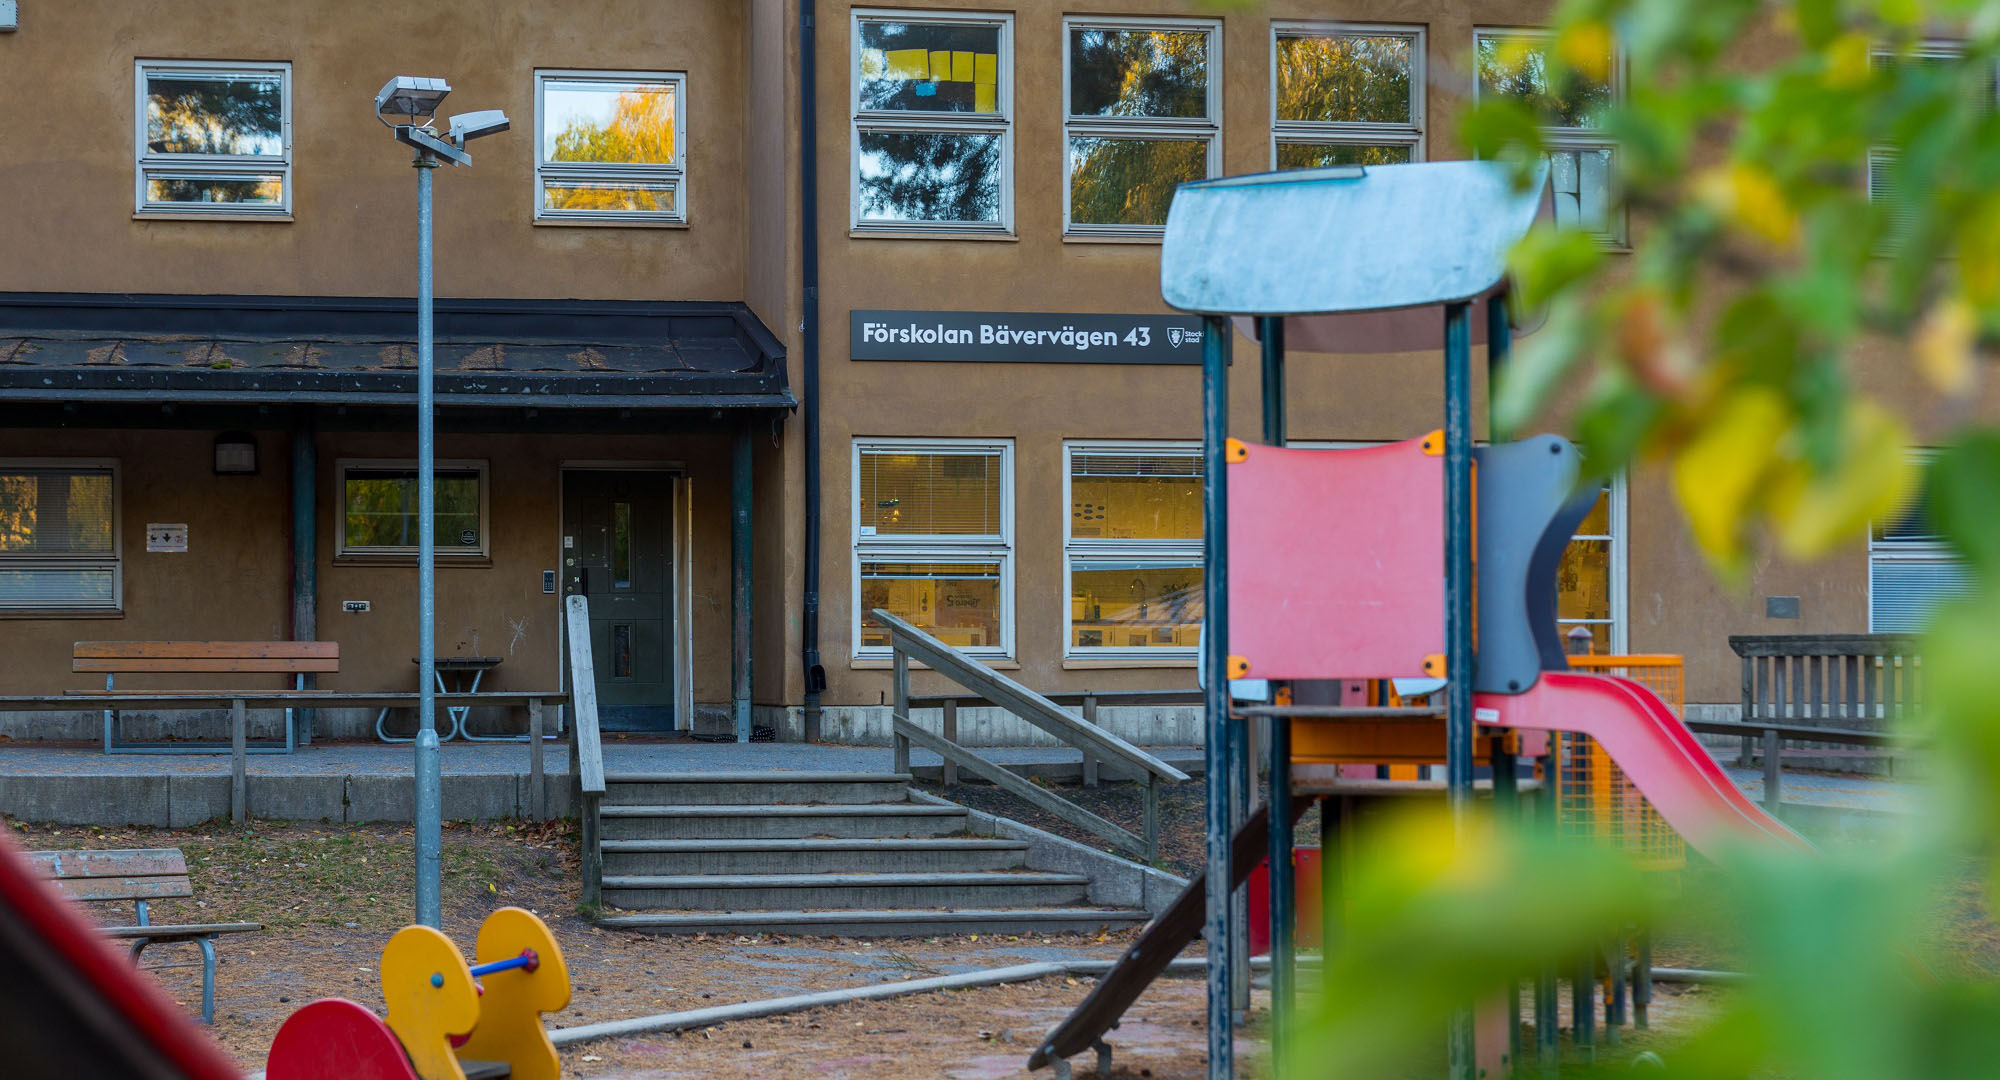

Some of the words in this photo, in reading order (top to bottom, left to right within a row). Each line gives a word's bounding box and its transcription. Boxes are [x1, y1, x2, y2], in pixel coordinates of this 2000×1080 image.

[863, 322, 973, 344] Förskolan
[980, 324, 1118, 350] Bävervägen
[1123, 326, 1151, 347] 43
